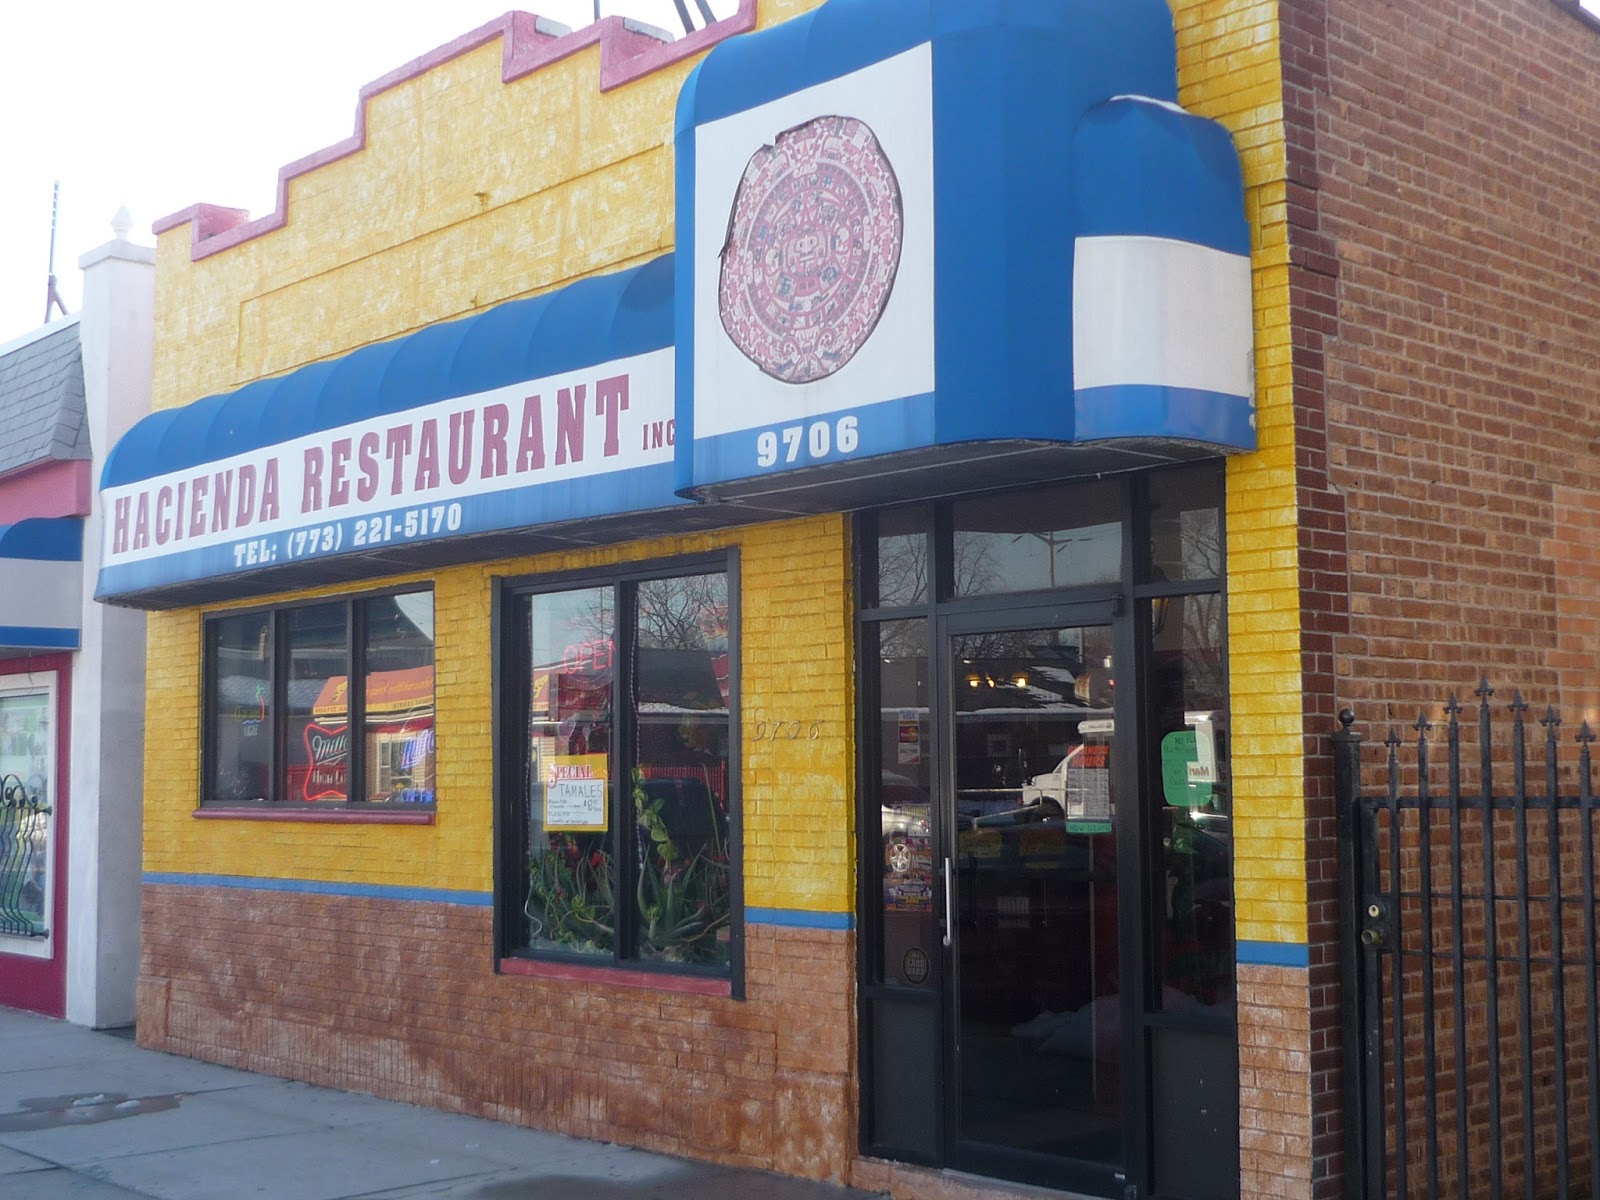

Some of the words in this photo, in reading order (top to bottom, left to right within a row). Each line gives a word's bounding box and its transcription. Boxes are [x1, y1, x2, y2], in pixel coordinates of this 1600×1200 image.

[757, 415, 859, 467] 9706
[112, 457, 280, 554] HACIENDA
[300, 373, 631, 513] RESTAURANT
[233, 540, 277, 568] TEL:
[286, 527, 343, 559] (773)
[353, 502, 463, 547] 221-5170
[752, 719, 825, 742] 9706
[312, 735, 348, 761] Mille
[548, 763, 594, 789] SPECIAL
[558, 783, 603, 798] TAMALES
